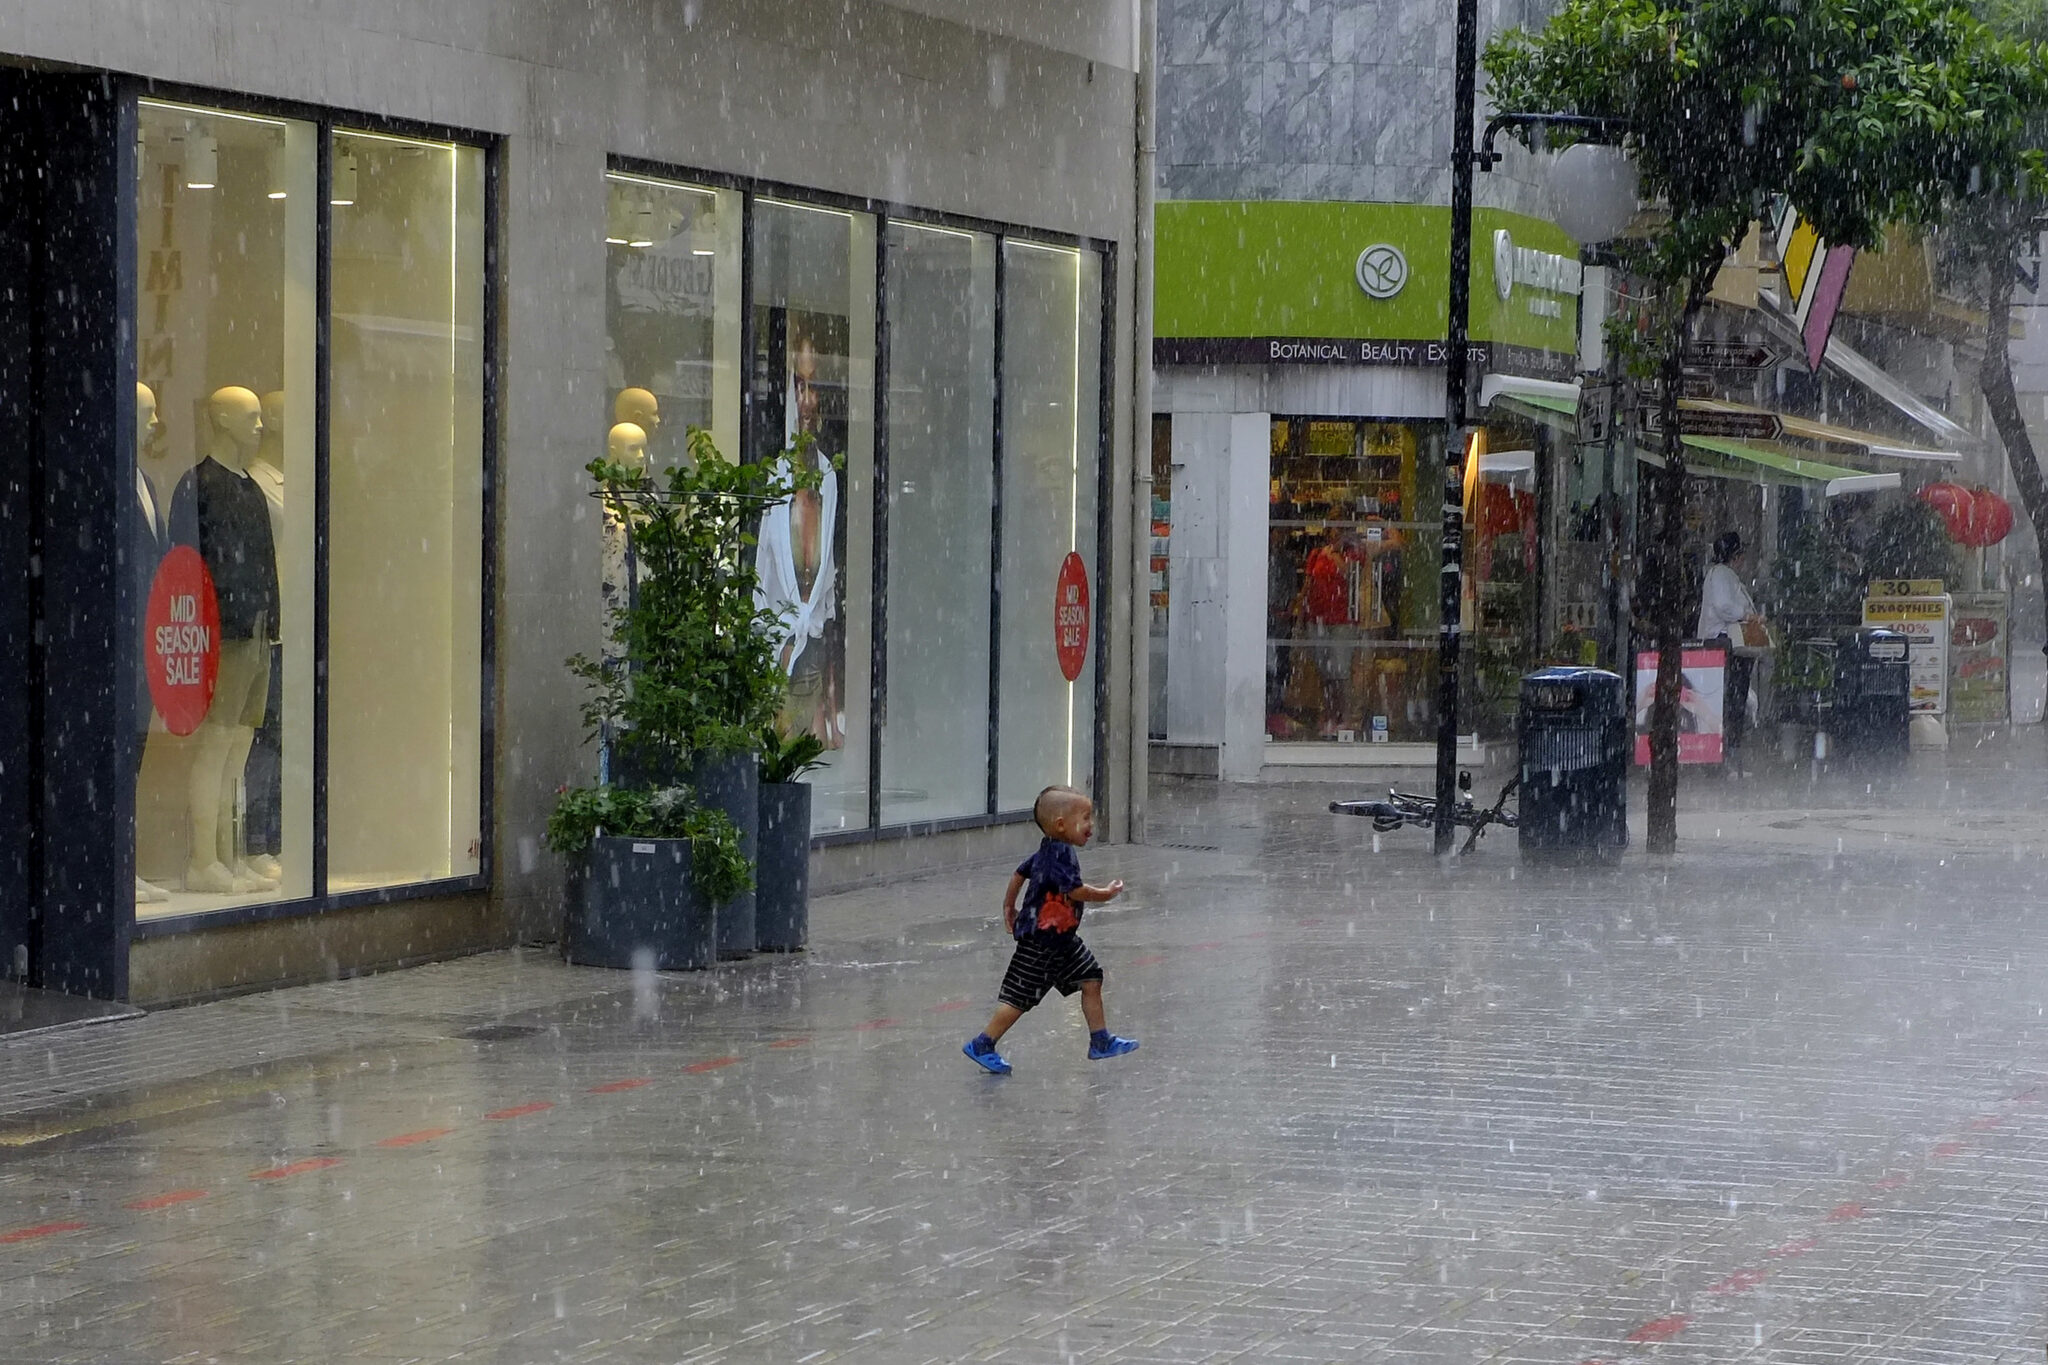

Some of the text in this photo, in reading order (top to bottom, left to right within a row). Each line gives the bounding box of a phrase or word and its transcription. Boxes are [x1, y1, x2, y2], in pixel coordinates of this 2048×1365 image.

[1270, 341, 1347, 359] BOTANICAL
[1361, 342, 1414, 361] BEAUTY
[1065, 584, 1079, 604] MID
[1882, 581, 1911, 596] 30
[170, 595, 196, 622] MID
[1059, 605, 1086, 626] SEASON
[1868, 603, 1942, 614] SMOOTHIES
[155, 625, 210, 655] SEASON
[1063, 627, 1080, 648] SALE
[166, 656, 200, 686] SALE
